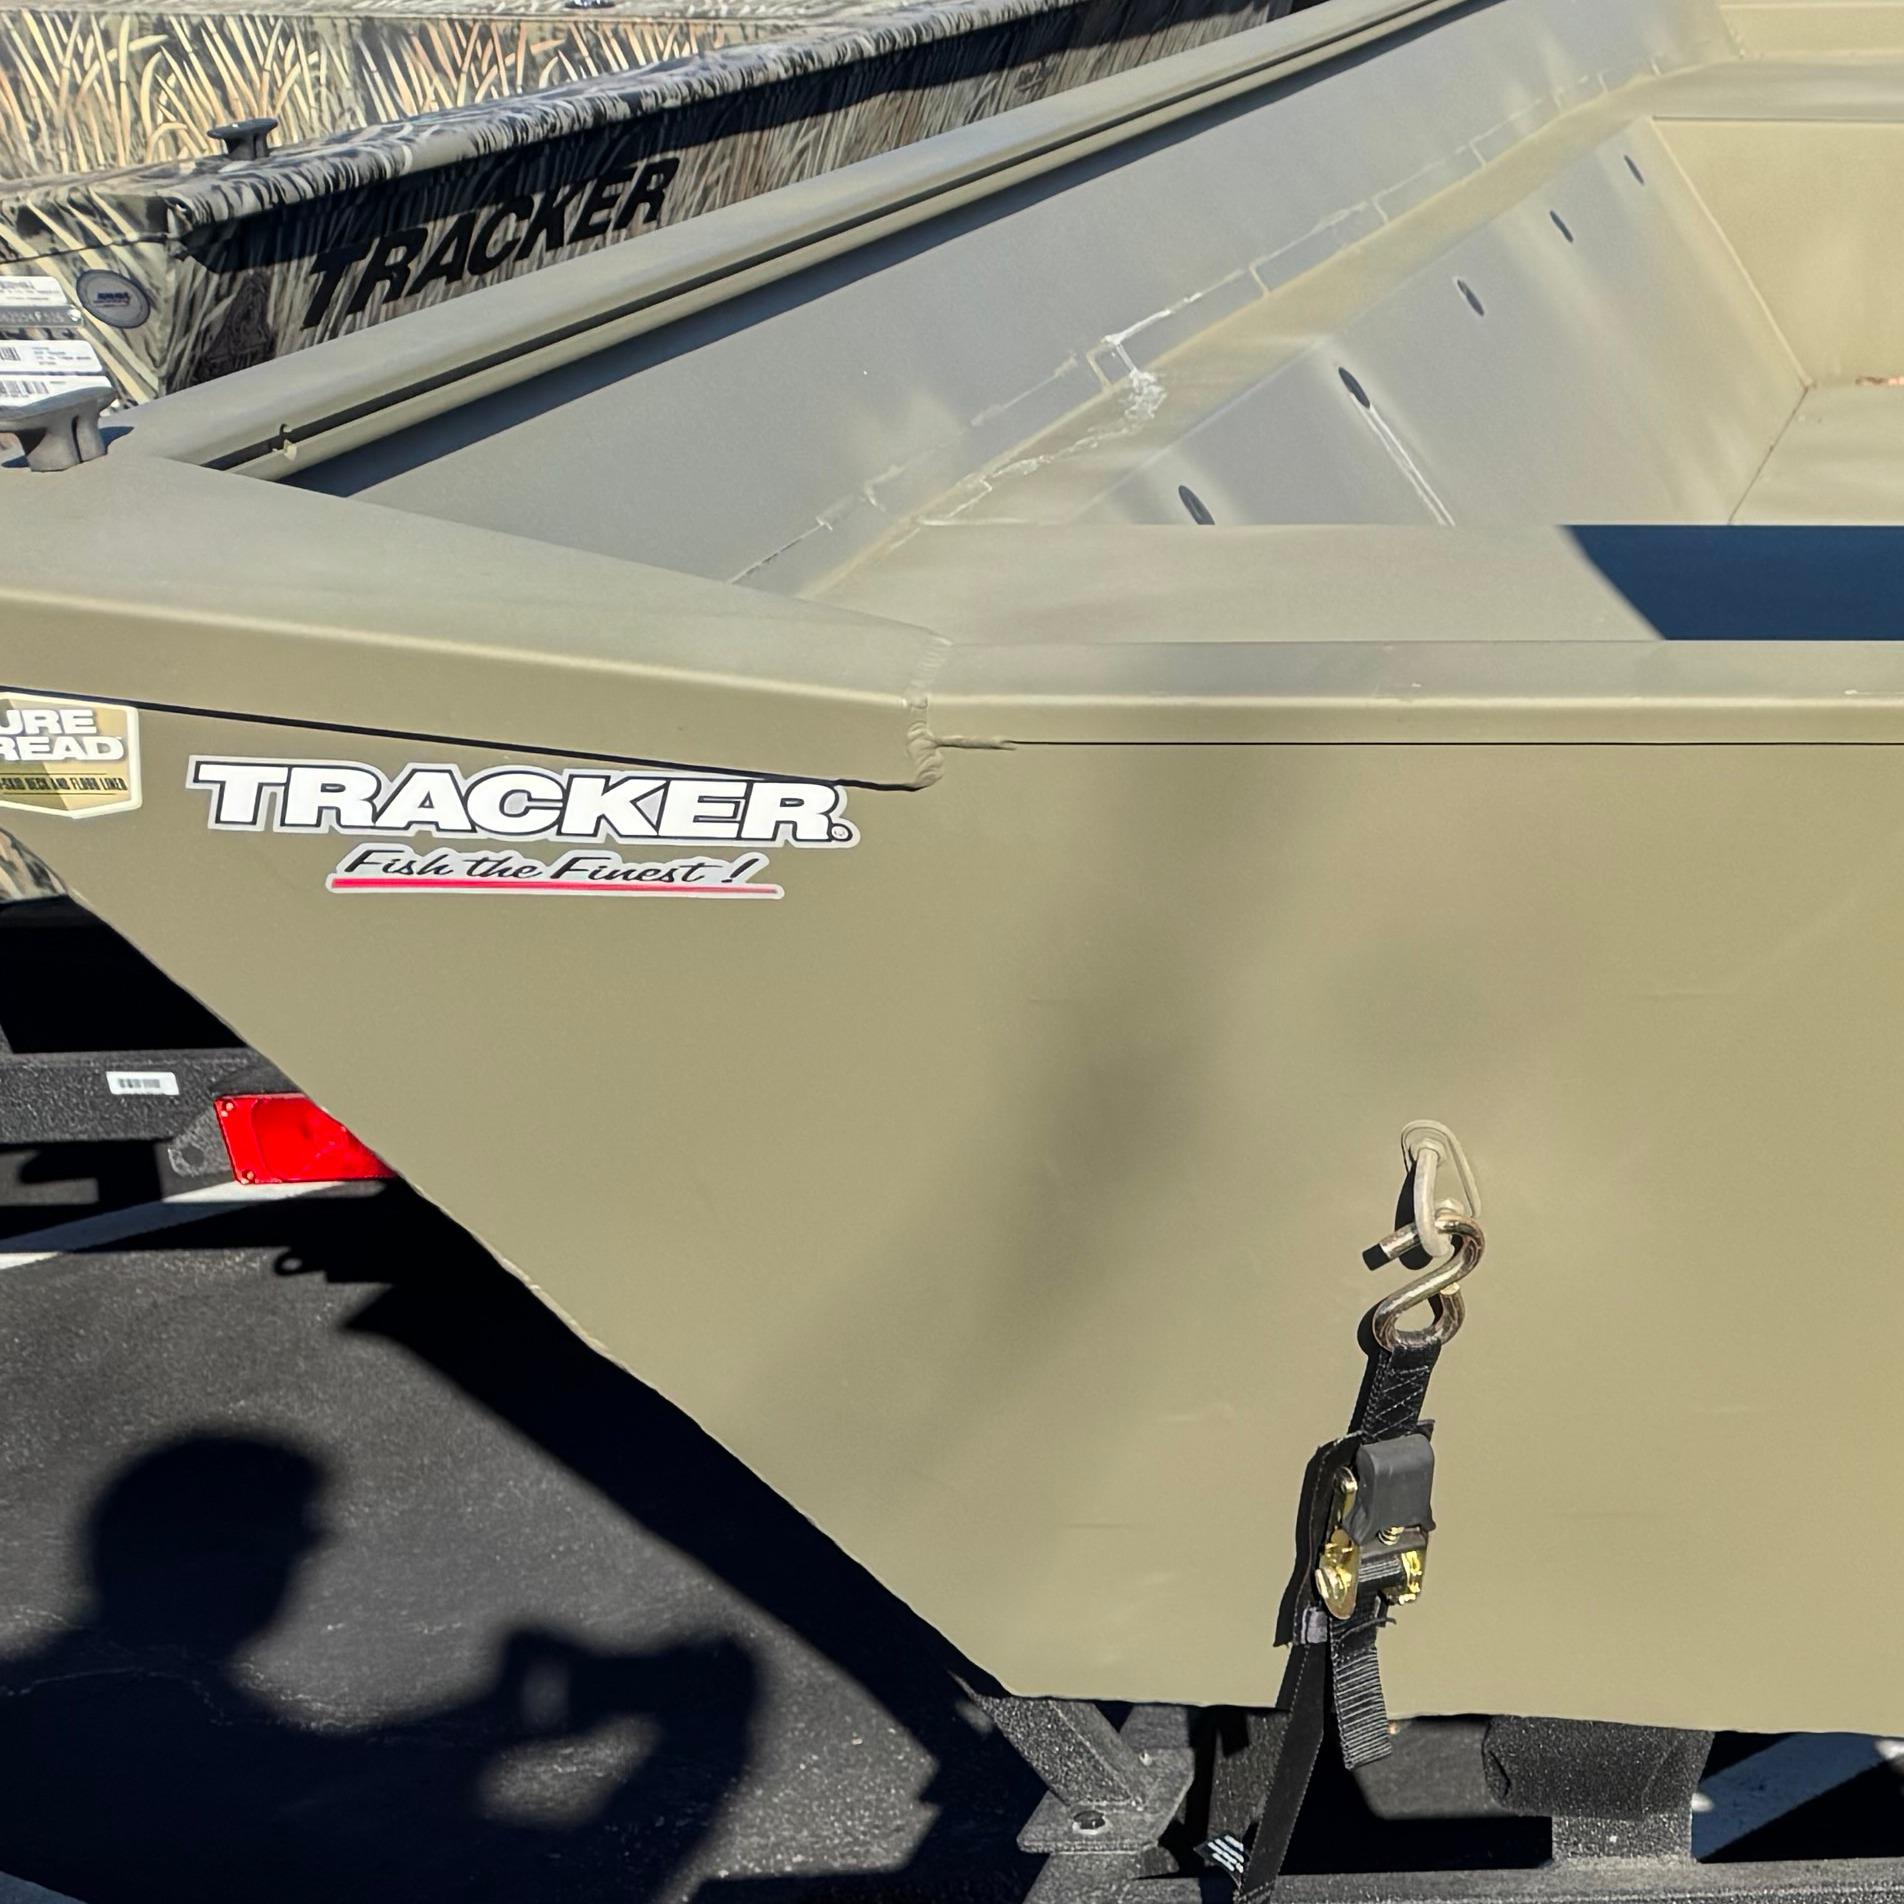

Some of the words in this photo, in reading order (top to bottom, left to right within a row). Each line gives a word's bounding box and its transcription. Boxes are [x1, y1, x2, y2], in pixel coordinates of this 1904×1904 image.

[299, 156, 681, 331] TRACKER
[193, 760, 838, 842] TRACKER
[344, 849, 454, 878] Fish
[463, 856, 543, 880] the
